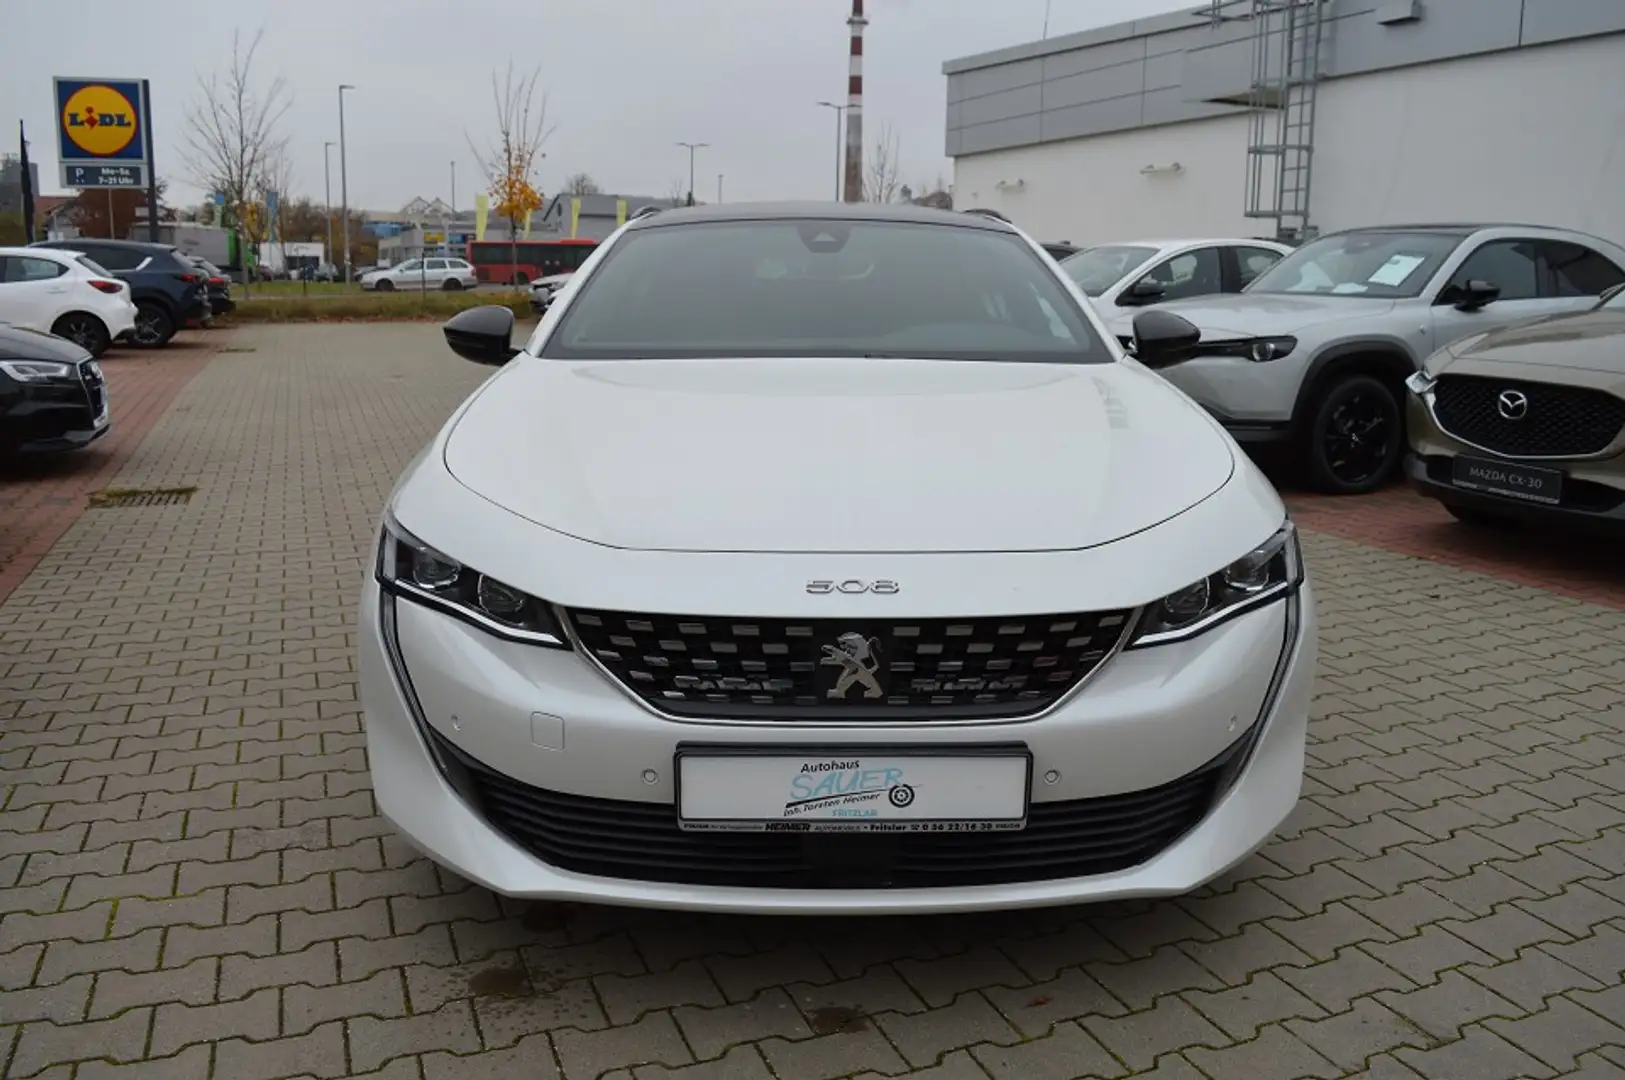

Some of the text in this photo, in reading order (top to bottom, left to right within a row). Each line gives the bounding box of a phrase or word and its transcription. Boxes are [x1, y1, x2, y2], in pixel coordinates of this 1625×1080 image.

[68, 106, 132, 129] LIDL
[1469, 466, 1506, 483] MAZDA
[806, 579, 900, 594] 508
[800, 759, 860, 773] Autohaus
[790, 768, 904, 800] SAUER
[804, 799, 840, 812] Torsten
